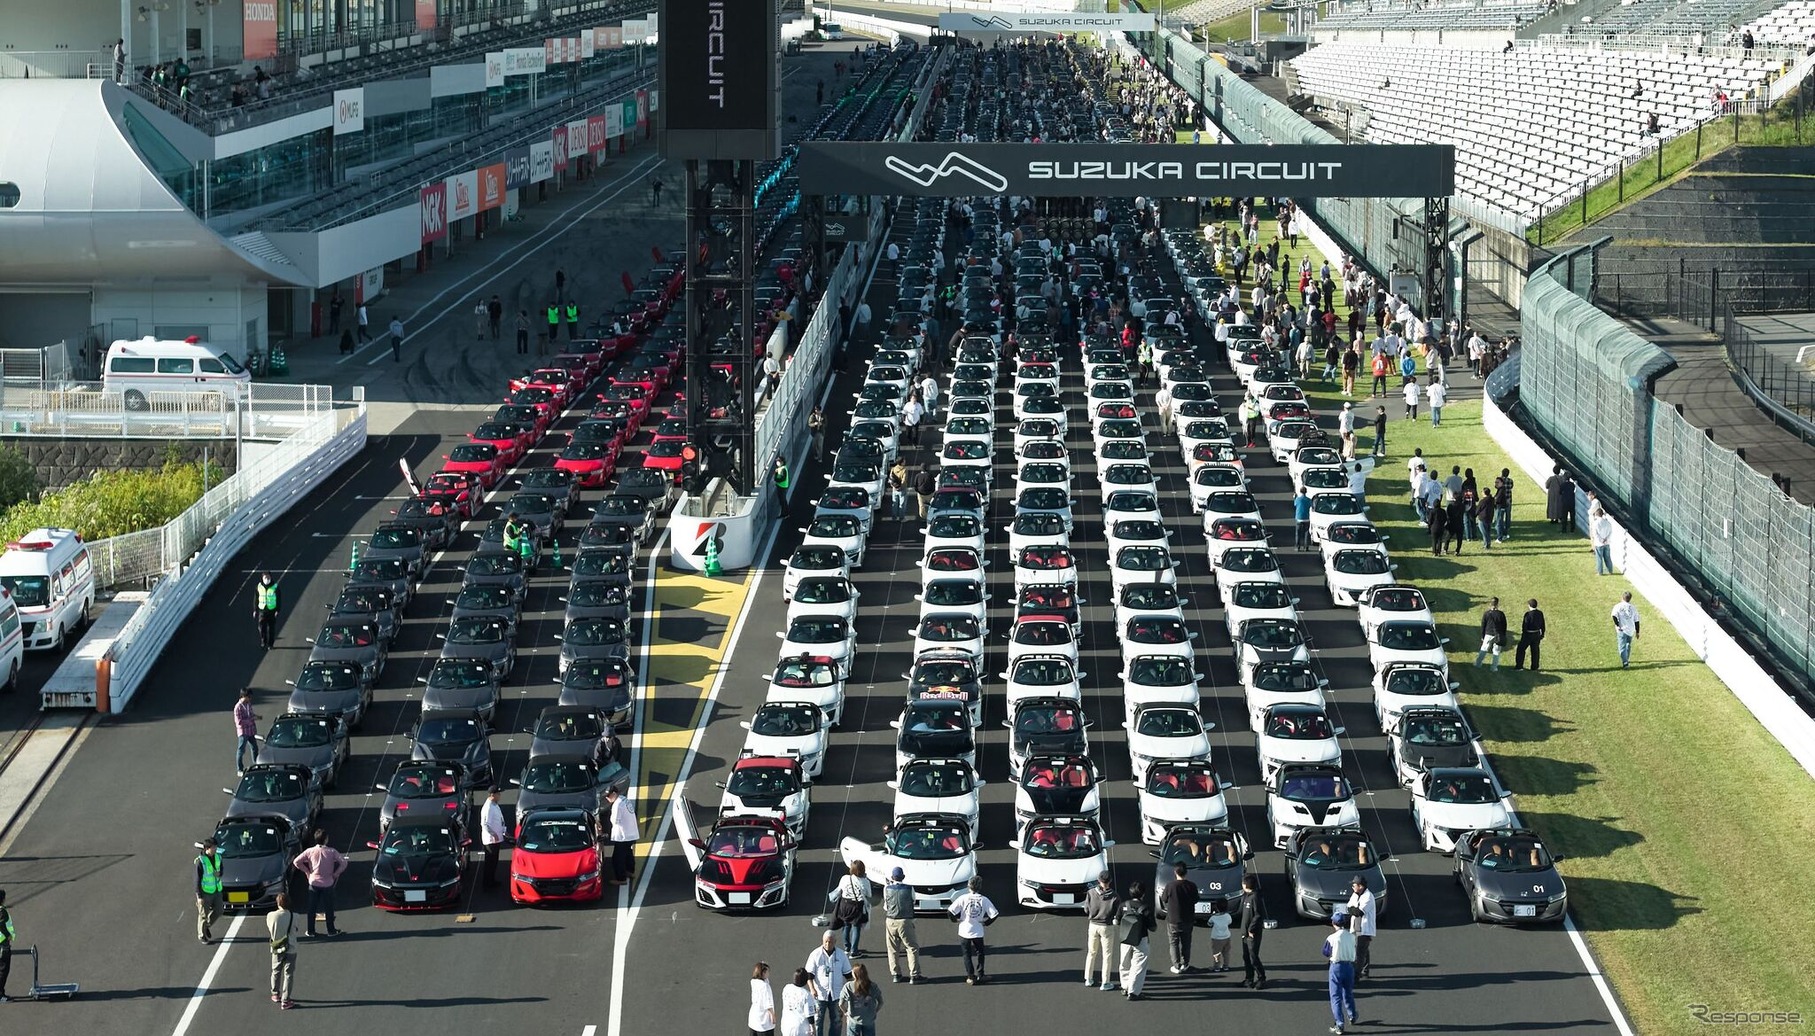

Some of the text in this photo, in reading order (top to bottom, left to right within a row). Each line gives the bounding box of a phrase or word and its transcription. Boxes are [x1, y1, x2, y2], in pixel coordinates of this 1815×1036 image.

[245, 3, 275, 21] HONDA
[1019, 18, 1123, 26] SUZUKA CIRCUIT
[347, 101, 359, 119] MUFG
[570, 124, 587, 152] DENSO
[589, 120, 604, 148] DENSO
[553, 132, 566, 167] NGK
[1028, 160, 1343, 181] SUZUKA CIRCUIT
[422, 190, 442, 237] NGK
[920, 691, 969, 701] Red Bull
[1209, 882, 1222, 890] 03
[1532, 884, 1545, 893] 01
[1202, 904, 1210, 913] 03
[1526, 907, 1535, 916] 01
